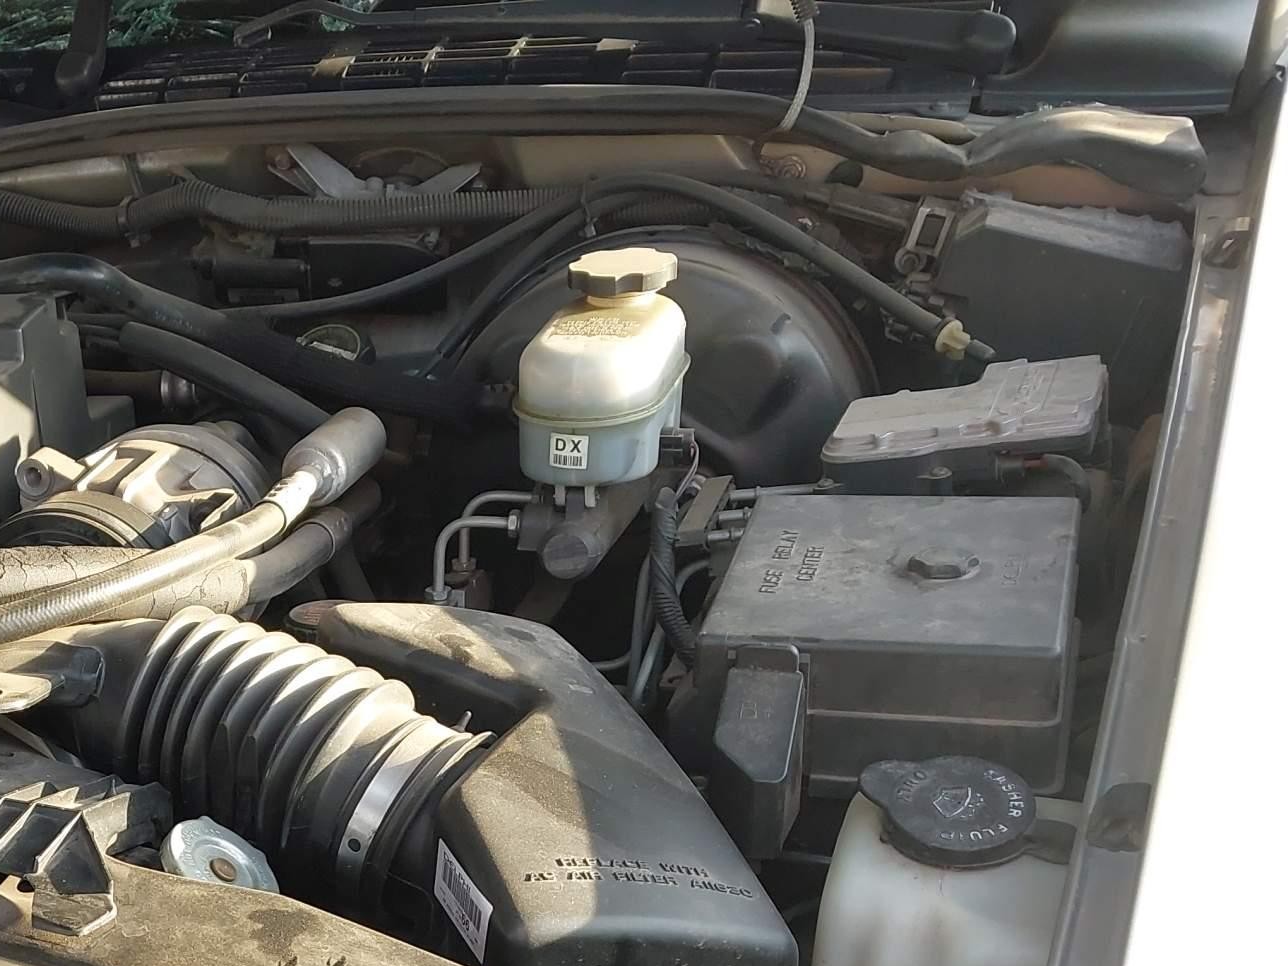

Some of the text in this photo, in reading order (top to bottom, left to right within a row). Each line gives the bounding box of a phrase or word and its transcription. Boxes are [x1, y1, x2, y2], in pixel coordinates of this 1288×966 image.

[555, 437, 584, 453] DX
[758, 530, 800, 594] FUSE RELAY
[795, 545, 825, 581] CENTER
[555, 857, 710, 878] REPLACE WITH
[565, 871, 603, 881] AIR
[612, 872, 679, 886] FILTER
